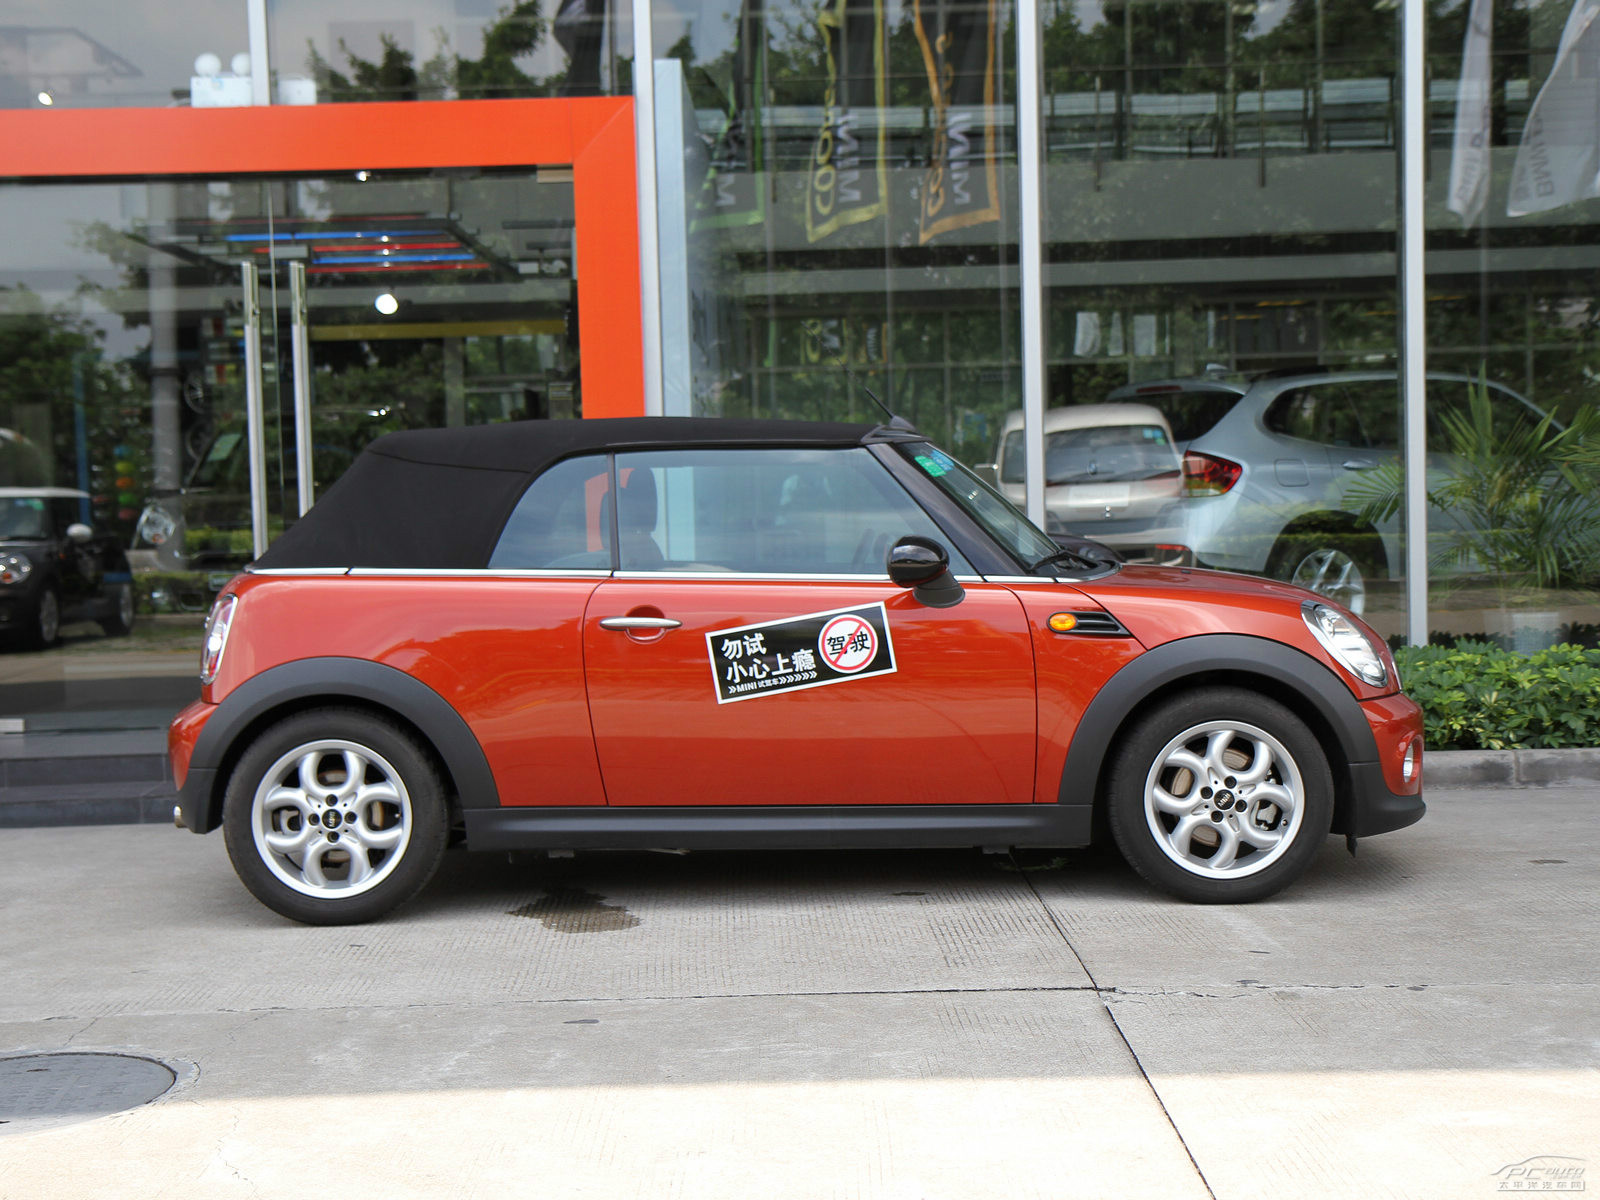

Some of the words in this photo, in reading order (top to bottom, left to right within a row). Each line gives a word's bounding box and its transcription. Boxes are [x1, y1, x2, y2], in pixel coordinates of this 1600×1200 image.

[721, 632, 768, 660] 勿试
[827, 631, 871, 655] 驾驶
[726, 648, 817, 684] 小心上瘾
[737, 682, 757, 693] MINI
